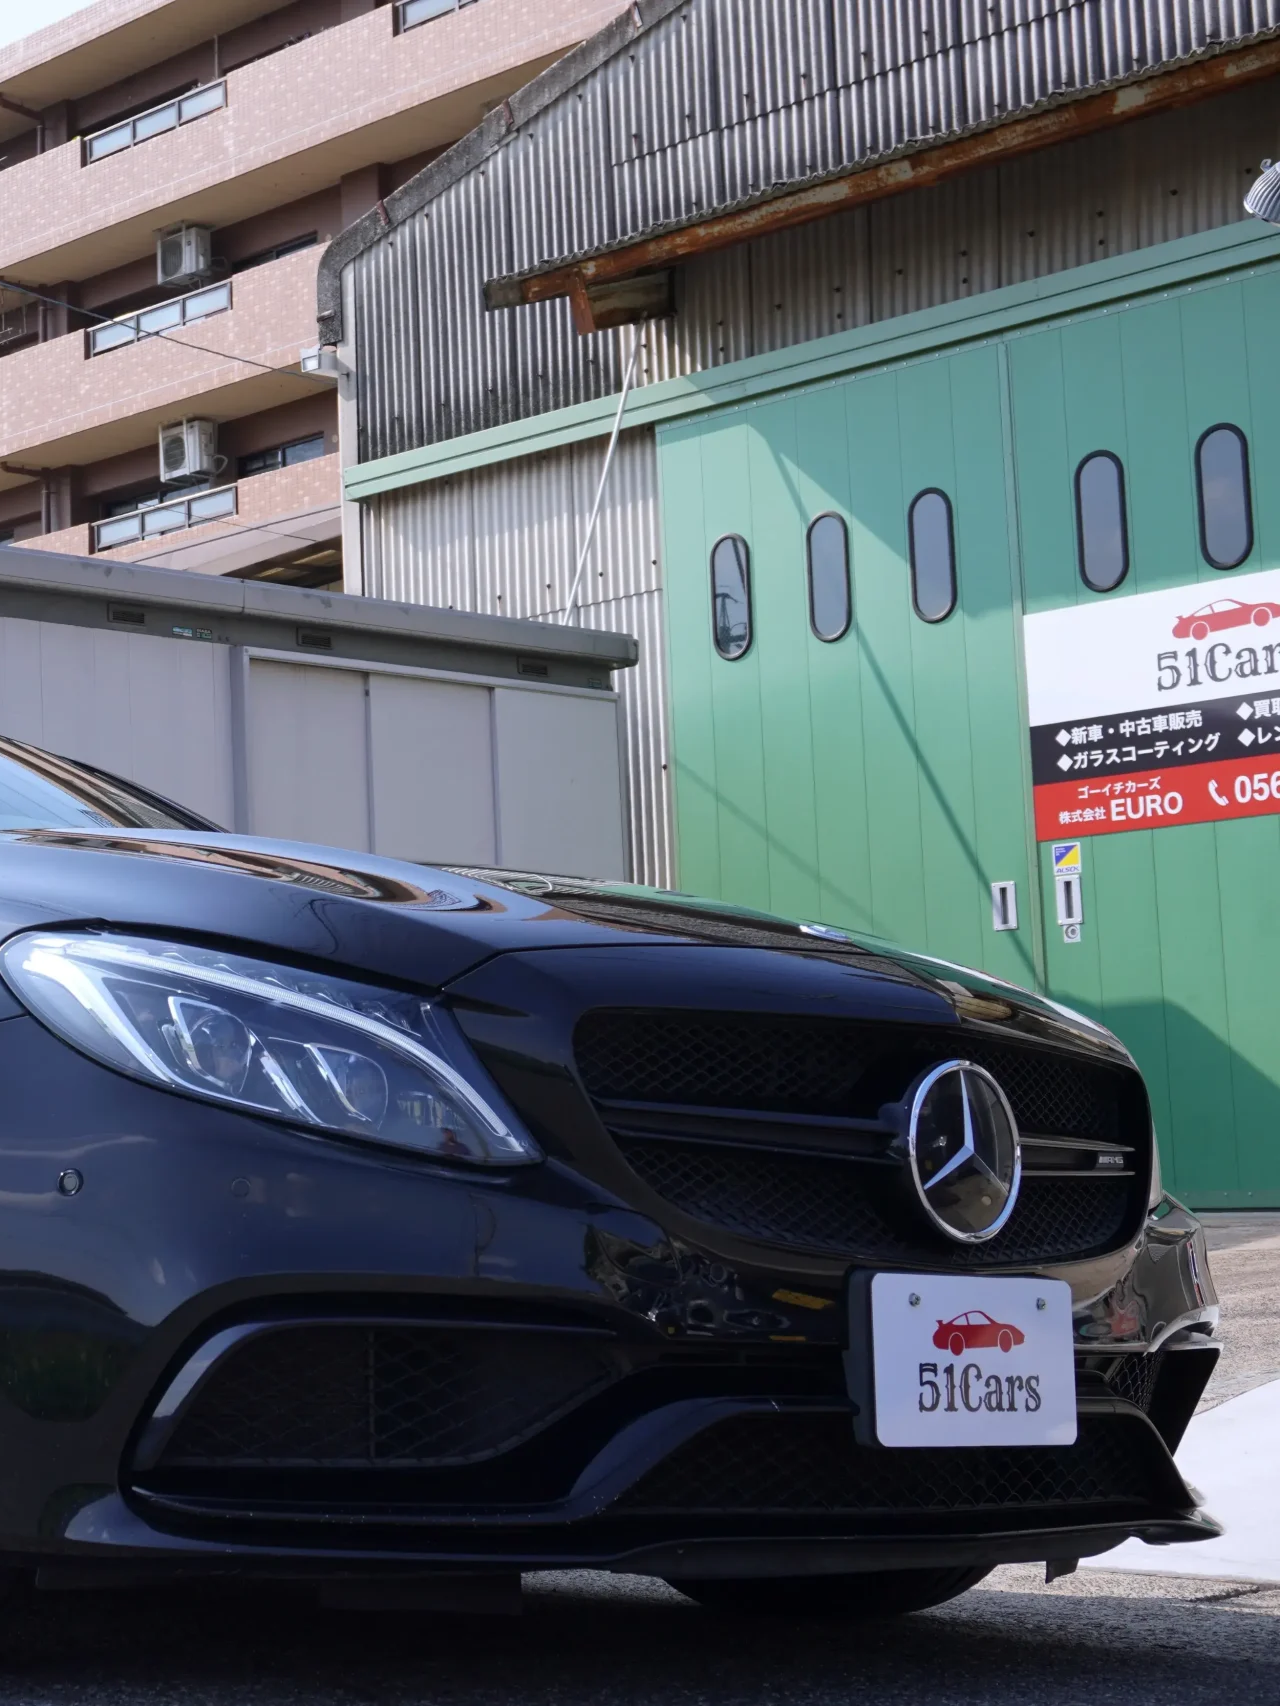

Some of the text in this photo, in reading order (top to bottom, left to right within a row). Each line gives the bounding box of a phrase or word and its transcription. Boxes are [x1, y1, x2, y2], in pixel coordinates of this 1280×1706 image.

[1156, 641, 1280, 692] 51Car
[1071, 709, 1203, 746] 新車・中古車販売
[1073, 732, 1221, 770] ガラスコーティング
[1077, 776, 1162, 799] ゴーイチカーズ
[1058, 791, 1183, 825] 株式会社 EURO
[918, 1362, 1042, 1413] 51Cars
